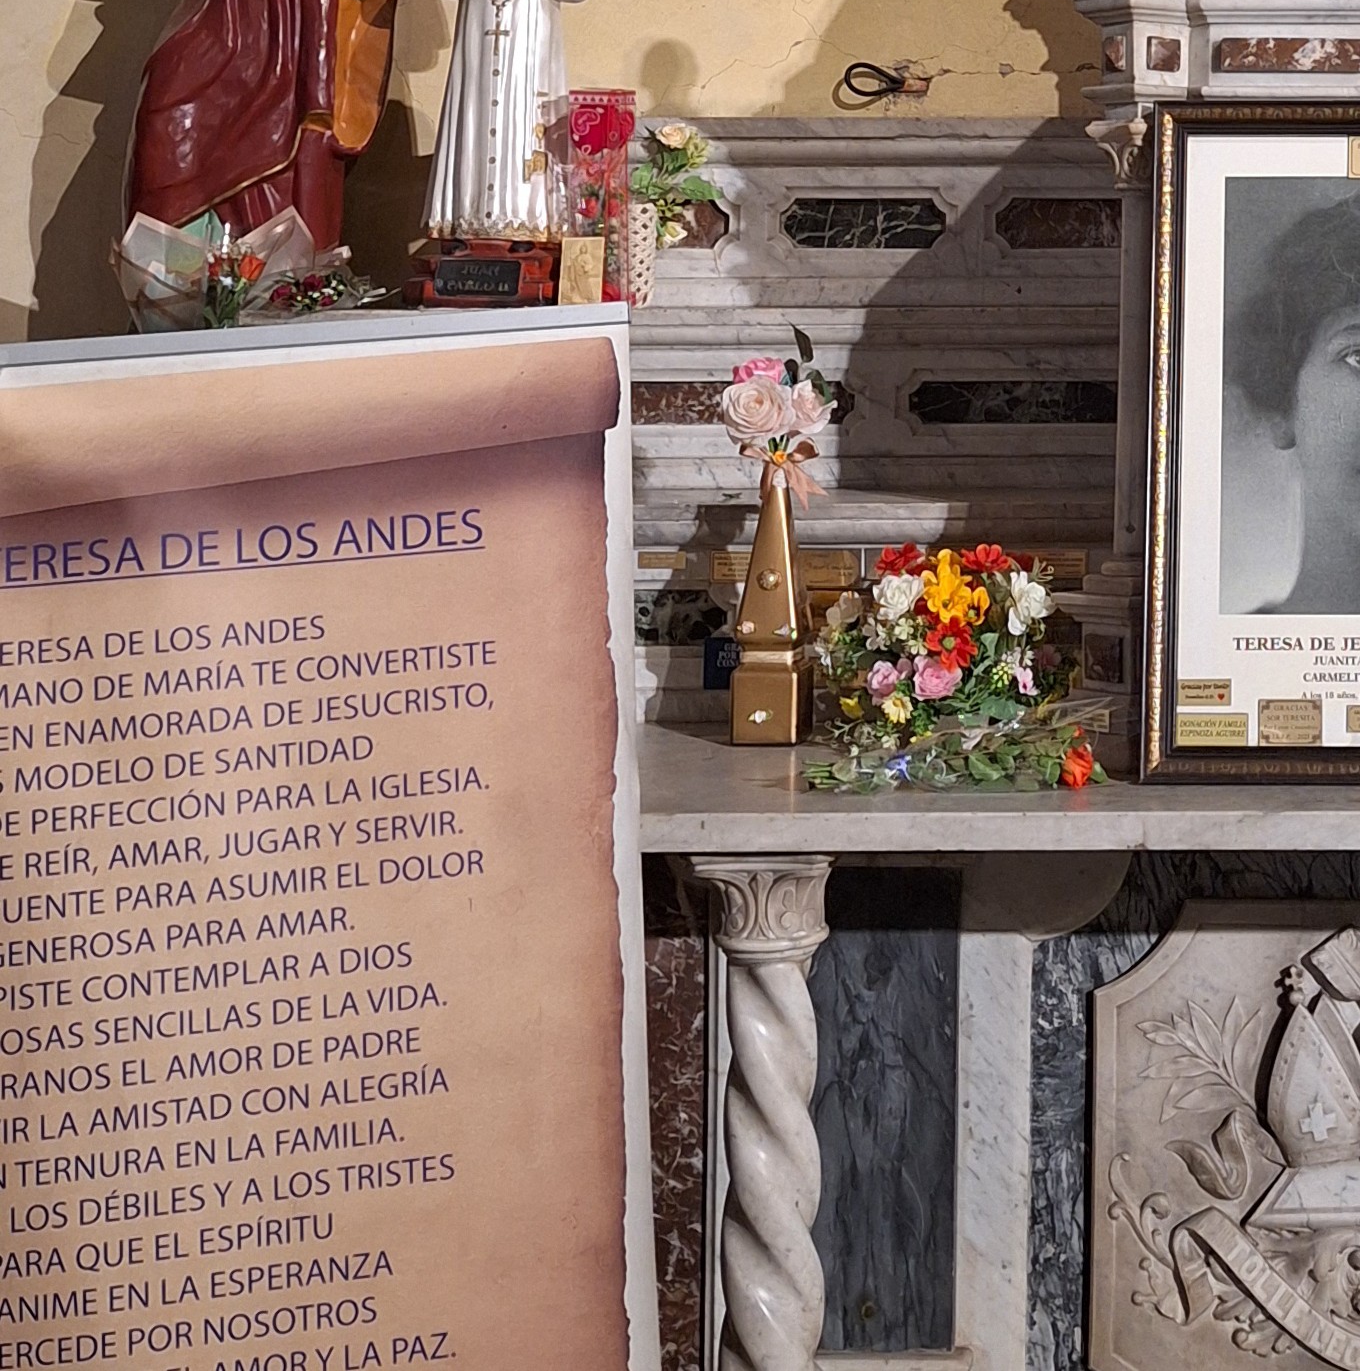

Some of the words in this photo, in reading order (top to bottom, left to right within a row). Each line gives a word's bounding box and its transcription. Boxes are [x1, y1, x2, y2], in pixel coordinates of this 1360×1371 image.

[0, 537, 145, 582] ERESA
[162, 531, 220, 569] DE
[237, 523, 318, 564] LOS
[333, 509, 482, 556] ANDES
[105, 631, 144, 658] DE
[155, 625, 211, 653] LOS
[221, 615, 325, 648] ANDES
[1232, 636, 1304, 651] TERESA
[1310, 636, 1336, 651] DE
[94, 673, 134, 701] DE
[144, 660, 245, 696] MARÍA
[251, 660, 287, 686] TE
[297, 641, 497, 682] CONVERTISTE
[46, 705, 253, 747] ENAMORADA
[264, 700, 303, 727] DE
[311, 683, 494, 723] JESUCRISTO,
[15, 756, 154, 793] MODELO
[165, 751, 205, 779] DE
[215, 735, 373, 774] SANTIDAD
[32, 789, 224, 835] PERFECCIÓN
[237, 783, 315, 814] PARA
[326, 778, 362, 805] LA
[372, 766, 489, 801] IGLESIA.
[25, 843, 98, 879] REÍR,
[108, 837, 209, 870] AMAR,
[218, 824, 320, 859] JUGAR
[328, 821, 346, 847] Y
[356, 811, 463, 844] SERVIR.
[116, 880, 196, 912] PARA
[206, 866, 327, 903] ASUMIR
[337, 862, 370, 889] EL
[380, 850, 484, 884] DOLOR
[0, 928, 156, 968] ENEROSA
[167, 918, 246, 950] PARA
[256, 907, 355, 940] AMAR.
[82, 955, 299, 1002] CONTEMPLAR
[309, 952, 330, 978] A
[340, 942, 412, 974] DIOS
[95, 1002, 261, 1046] SENCILLAS
[273, 996, 312, 1025] DE
[323, 991, 360, 1019] LA
[366, 982, 447, 1013] VIDA.
[122, 1059, 156, 1087] EL
[165, 1046, 263, 1082] AMOR
[274, 1039, 313, 1068] DE
[324, 1027, 421, 1063] PADRE
[0, 1117, 29, 1145] IR
[40, 1112, 79, 1140] LA
[89, 1094, 232, 1135] AMISTAD
[242, 1083, 309, 1115] CON
[320, 1063, 449, 1107] ALEGRÍA
[14, 1146, 165, 1187] TERNURA
[176, 1139, 215, 1169] EN
[228, 1133, 265, 1162] LA
[276, 1118, 405, 1156] FAMILIA.
[11, 1201, 68, 1233] LOS
[79, 1184, 205, 1226] DÉBILES
[213, 1180, 233, 1208] Y
[242, 1178, 263, 1205] A
[274, 1169, 330, 1201] LOS
[337, 1154, 455, 1192] TRISTES
[0, 1247, 66, 1279] ARA
[76, 1237, 144, 1272] QUE
[155, 1232, 189, 1261] EL
[200, 1213, 332, 1255] ESPÍRITU
[109, 1281, 149, 1312] EN
[162, 1276, 200, 1305] LA
[211, 1251, 393, 1298] ESPERANZA
[129, 1321, 193, 1356] POR
[204, 1296, 377, 1345] NOSOTROS
[315, 1346, 334, 1371] Y
[345, 1341, 382, 1371] LA
[392, 1332, 456, 1364] PAZ.
